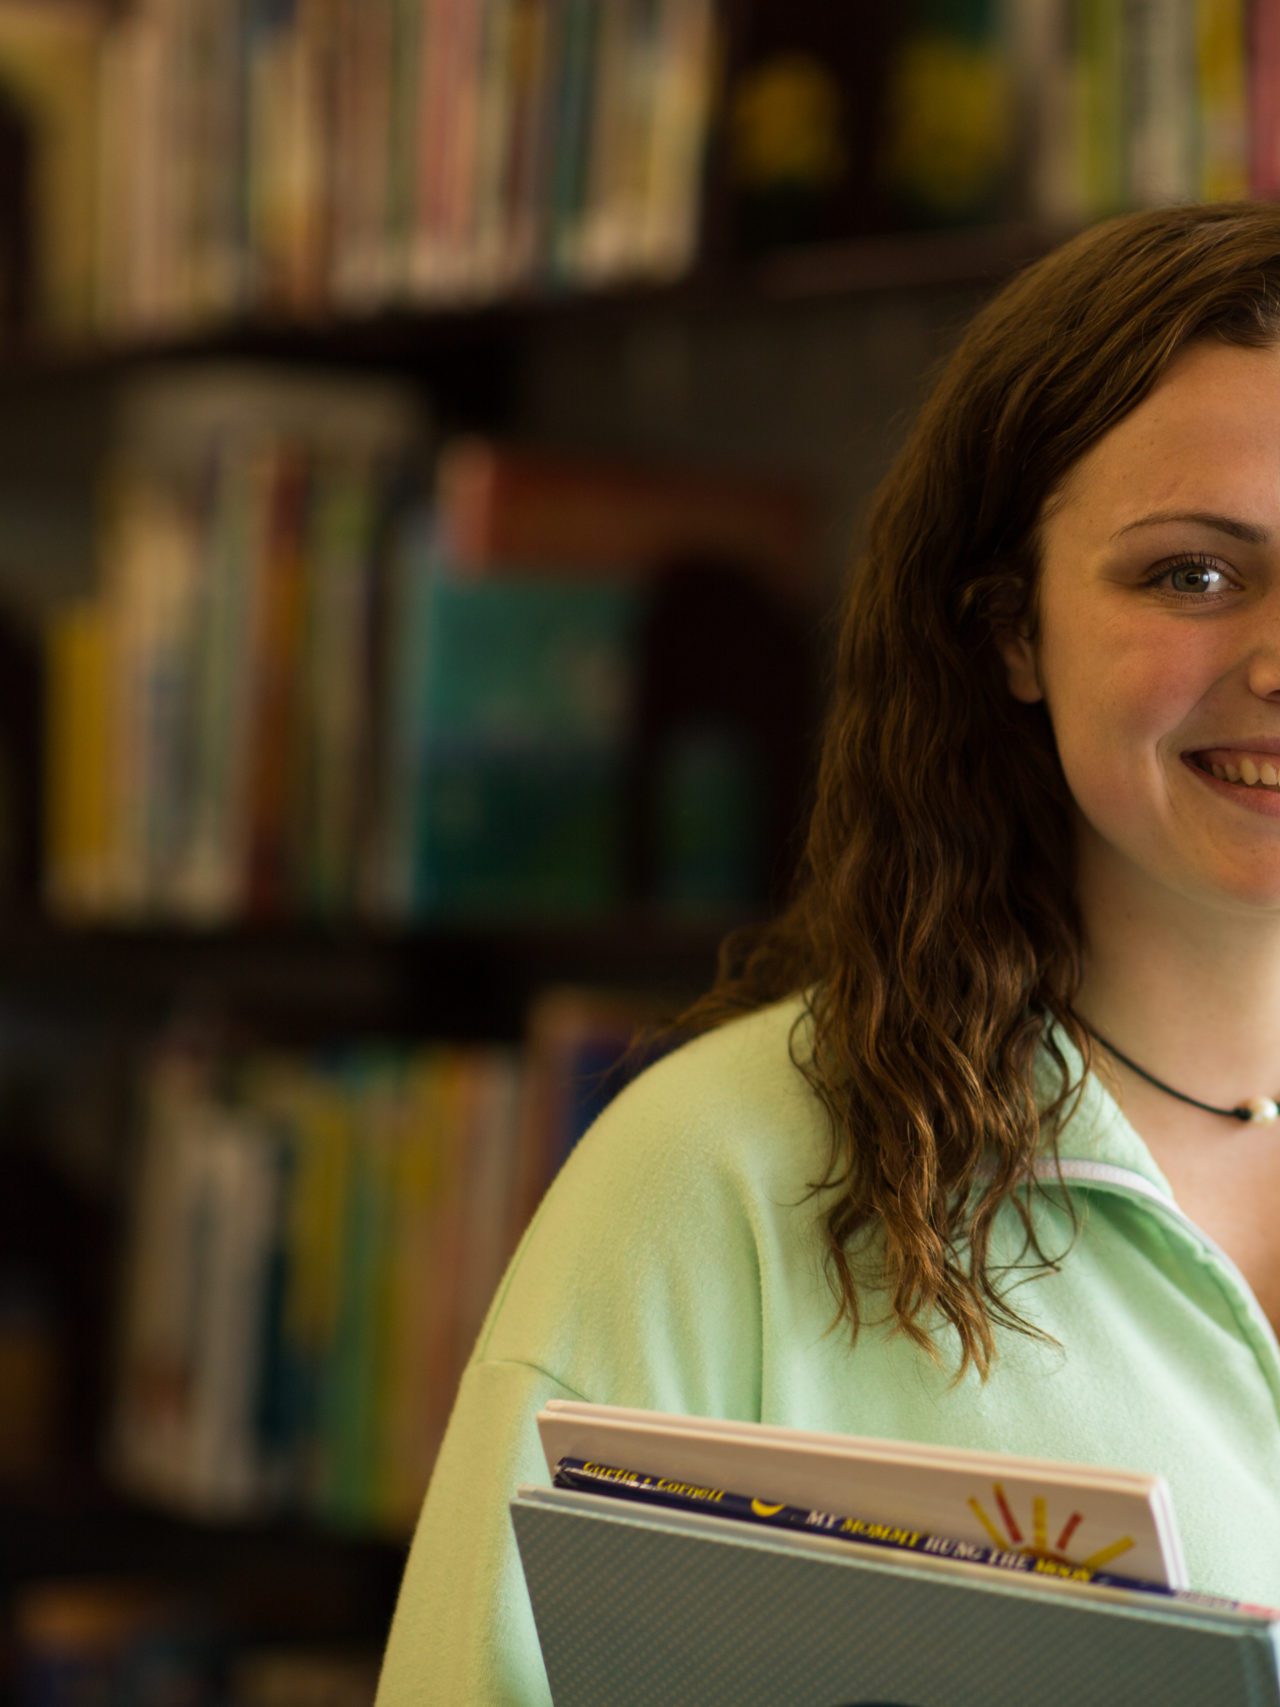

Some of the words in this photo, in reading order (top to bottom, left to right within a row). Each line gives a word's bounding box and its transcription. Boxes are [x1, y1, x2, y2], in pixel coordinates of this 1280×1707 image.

[583, 1461, 639, 1482] Curtis
[805, 1510, 836, 1529] MY
[841, 1518, 921, 1547] MOMMY
[924, 1535, 983, 1560] HUNG
[988, 1549, 1029, 1570] THE
